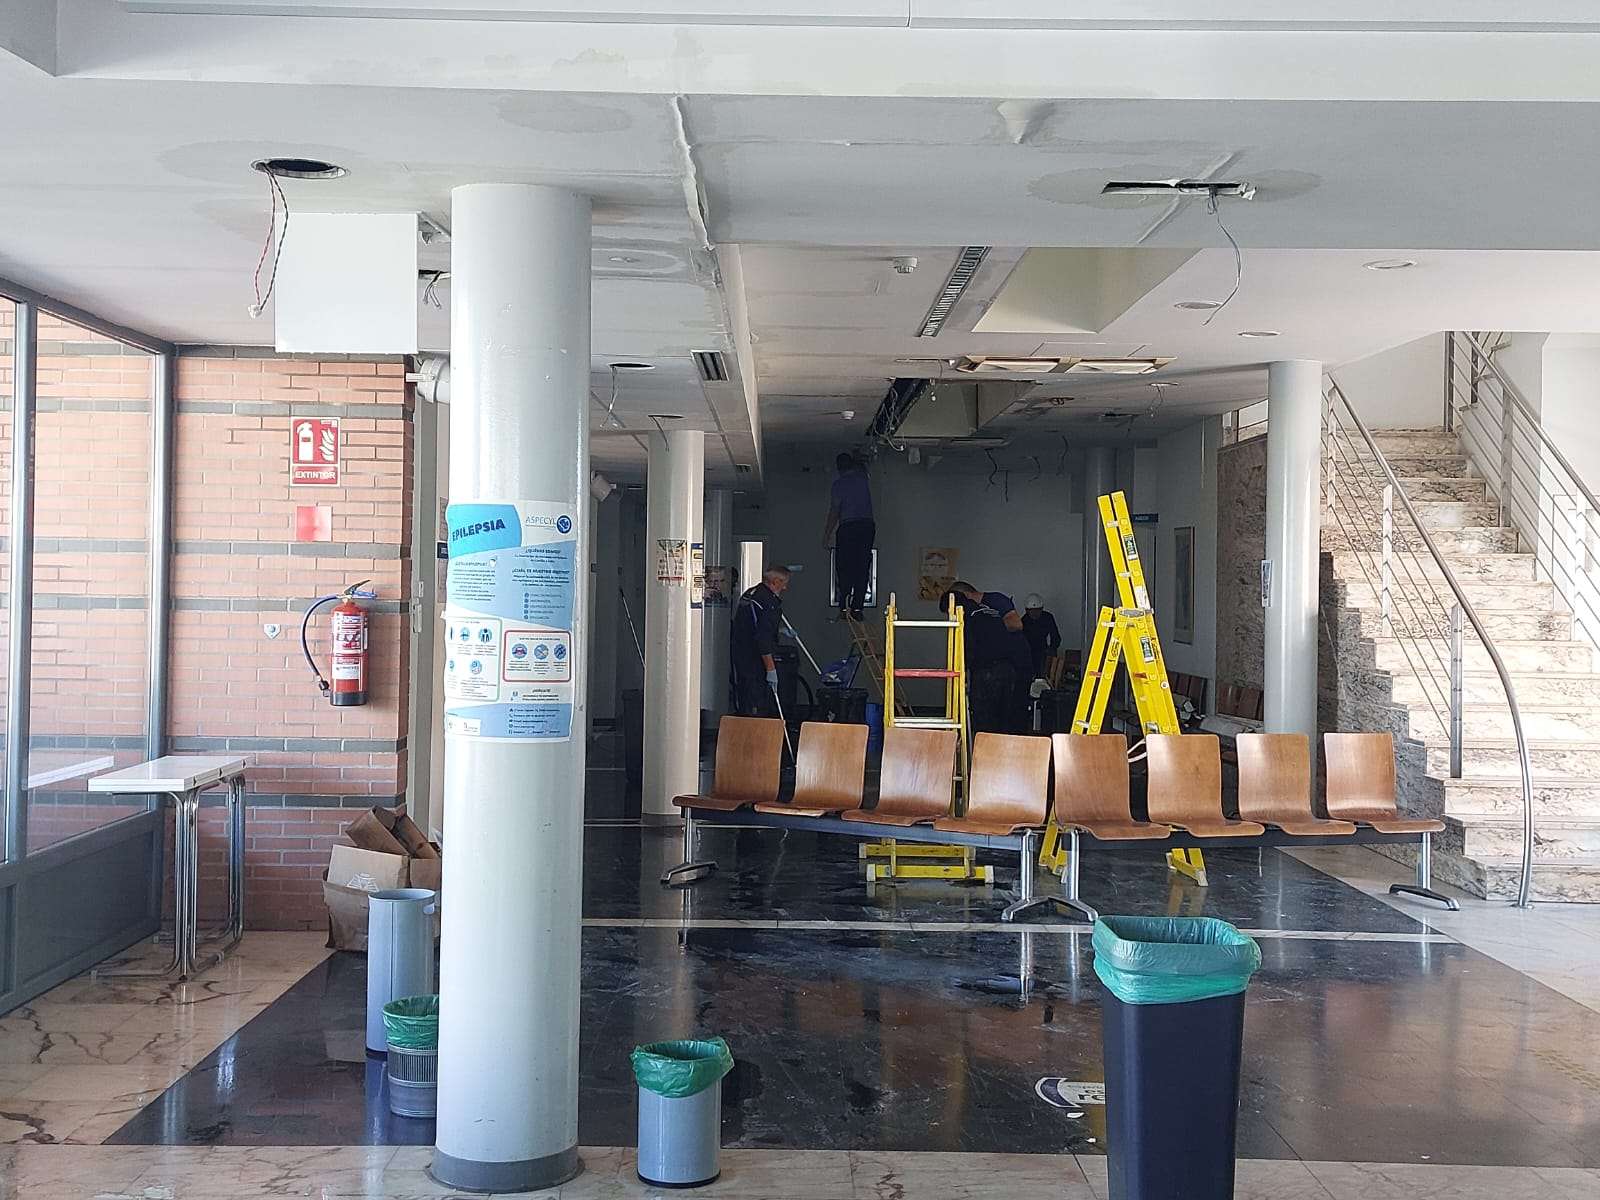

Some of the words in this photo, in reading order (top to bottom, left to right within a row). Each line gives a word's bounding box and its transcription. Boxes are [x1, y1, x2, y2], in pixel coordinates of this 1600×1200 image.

[294, 470, 336, 480] EXTINTOR
[525, 516, 557, 525] ASPECYL
[451, 518, 506, 542] EPILEPSIA
